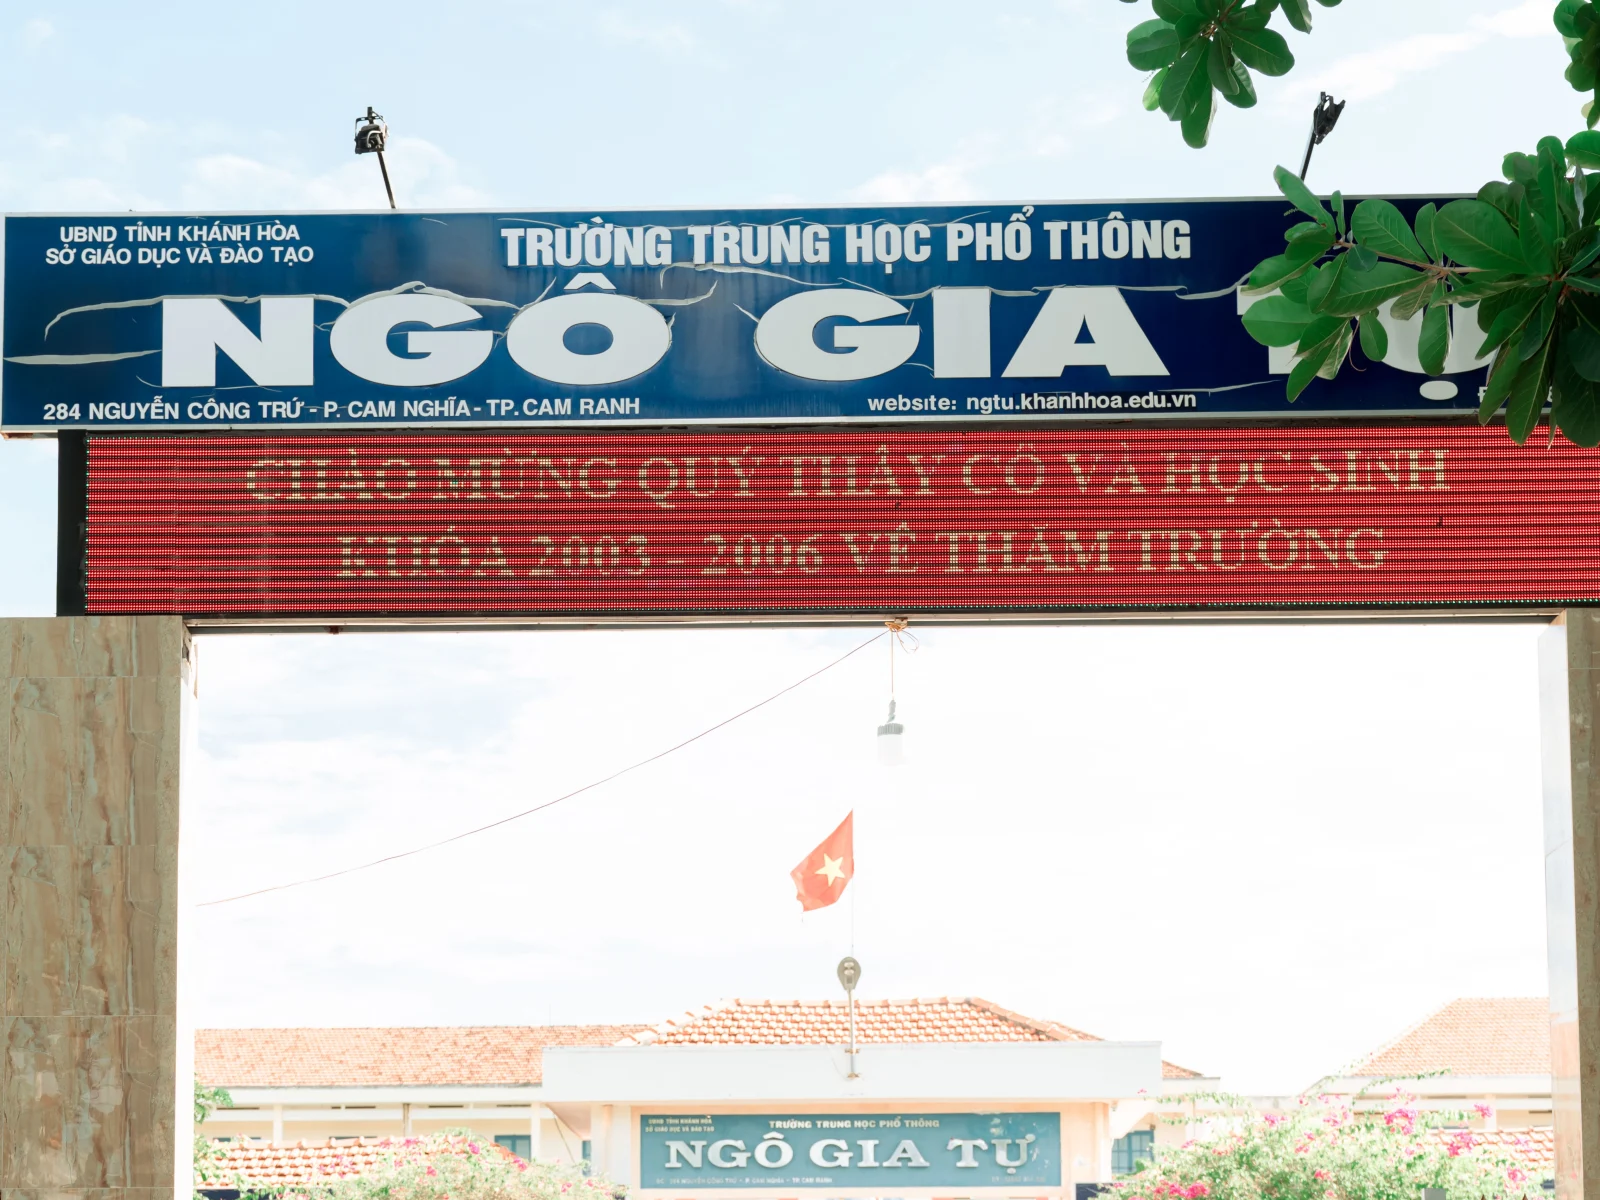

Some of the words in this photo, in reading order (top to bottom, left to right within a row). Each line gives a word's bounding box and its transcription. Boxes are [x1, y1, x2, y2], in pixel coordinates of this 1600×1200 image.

[60, 226, 117, 243] UBND
[124, 221, 171, 242] TỈNH
[178, 220, 250, 241] KHÁNH
[257, 220, 300, 241] HÒA
[501, 216, 672, 267] TRƯỜNG
[693, 223, 830, 264] TRUNG
[846, 223, 931, 274] HỌC
[946, 206, 1033, 262] PHỔ
[1044, 211, 1191, 260] THÔNG
[45, 244, 76, 265] SỞ
[81, 244, 132, 264] GIÁO
[138, 247, 180, 268] DỤC
[186, 243, 213, 264] VÀ
[220, 243, 263, 264] ĐÀO
[271, 246, 314, 266] TẠO
[162, 272, 672, 387] NGÔ
[755, 286, 1171, 381] GIA
[43, 403, 81, 420] 284
[89, 395, 180, 420] NGUYỄN
[187, 398, 250, 419] CÔNG
[258, 397, 304, 418] TRỨ
[324, 400, 341, 418] P.
[347, 400, 396, 417] CAM
[404, 396, 471, 417] NGHĨA
[523, 398, 572, 416] CAM
[579, 398, 640, 415] RANH
[868, 395, 957, 411] website:
[966, 392, 1197, 414] ngtu.khanhhoa.edu.vn
[246, 448, 417, 499] CHÀO
[432, 447, 622, 498] MỪNG
[638, 445, 766, 509] QUÝ
[962, 442, 1045, 494] CÔ
[1061, 442, 1147, 493] VÀ
[1160, 451, 1292, 503] HỌC
[1310, 449, 1451, 491] SINH
[336, 526, 515, 577] KHÓA
[529, 535, 651, 576] 2003
[702, 533, 823, 576] 2006
[935, 523, 1115, 573] THĂM
[1127, 518, 1390, 570] TRƯỜNG
[769, 1118, 812, 1129] TRƯỜNG
[816, 1120, 851, 1129] TRUNG
[854, 1119, 876, 1130] HỌC
[879, 1116, 901, 1128] PHỔ
[904, 1116, 940, 1128] THÔNG
[664, 1131, 794, 1168] NGÔ
[808, 1138, 931, 1168] GIA
[946, 1133, 1037, 1174] TỰ
